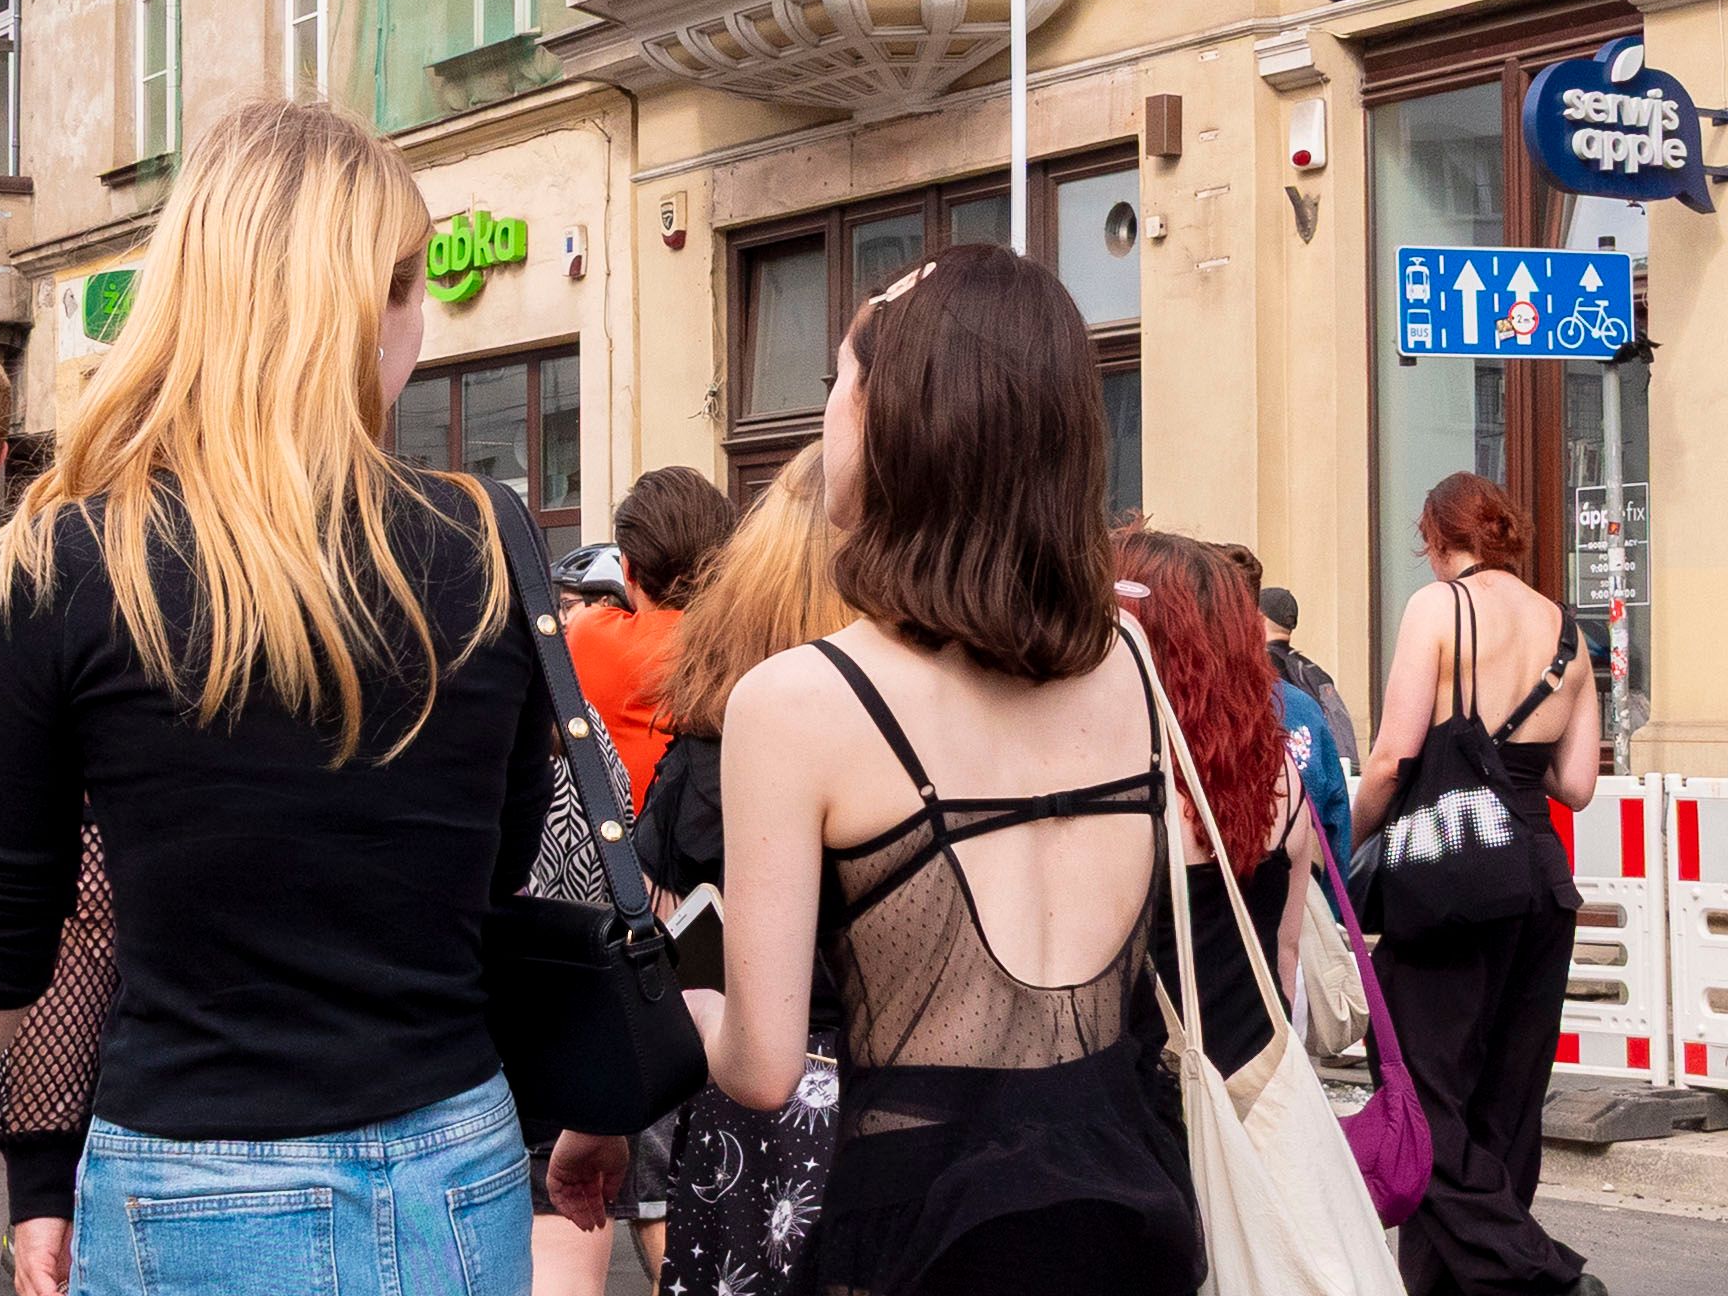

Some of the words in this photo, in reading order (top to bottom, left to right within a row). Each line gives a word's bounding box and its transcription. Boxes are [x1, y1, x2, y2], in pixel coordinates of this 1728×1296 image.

[1562, 88, 1680, 131] serwis
[1571, 122, 1688, 174] apple
[426, 210, 529, 280] abka
[1410, 327, 1429, 338] BUS
